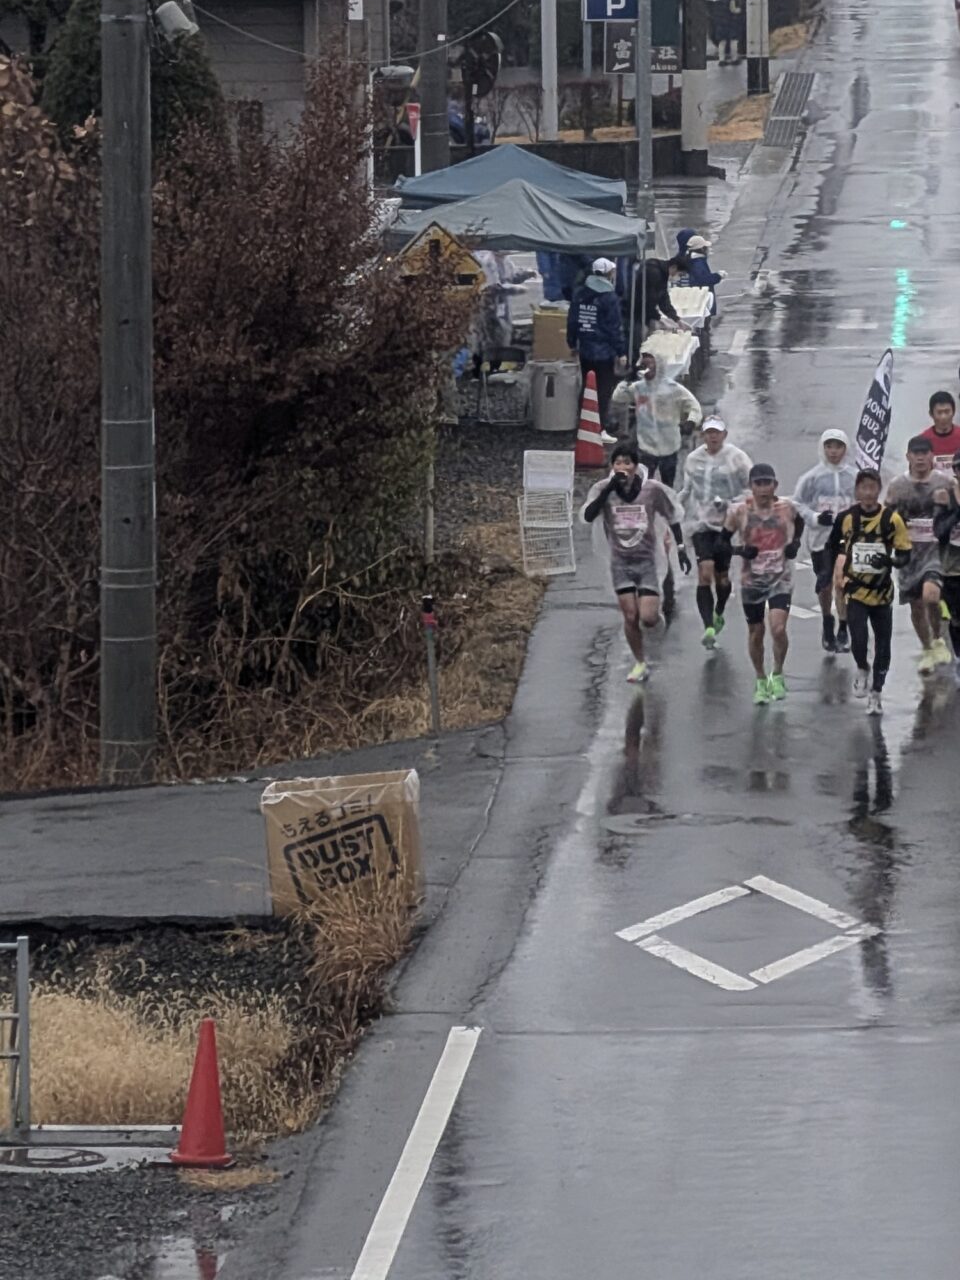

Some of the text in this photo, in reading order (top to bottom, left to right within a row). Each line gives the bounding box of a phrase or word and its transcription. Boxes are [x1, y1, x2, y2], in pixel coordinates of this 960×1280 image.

[613, 39, 678, 60] 富荘
[297, 826, 375, 869] DUST
[314, 853, 376, 892] BOX
